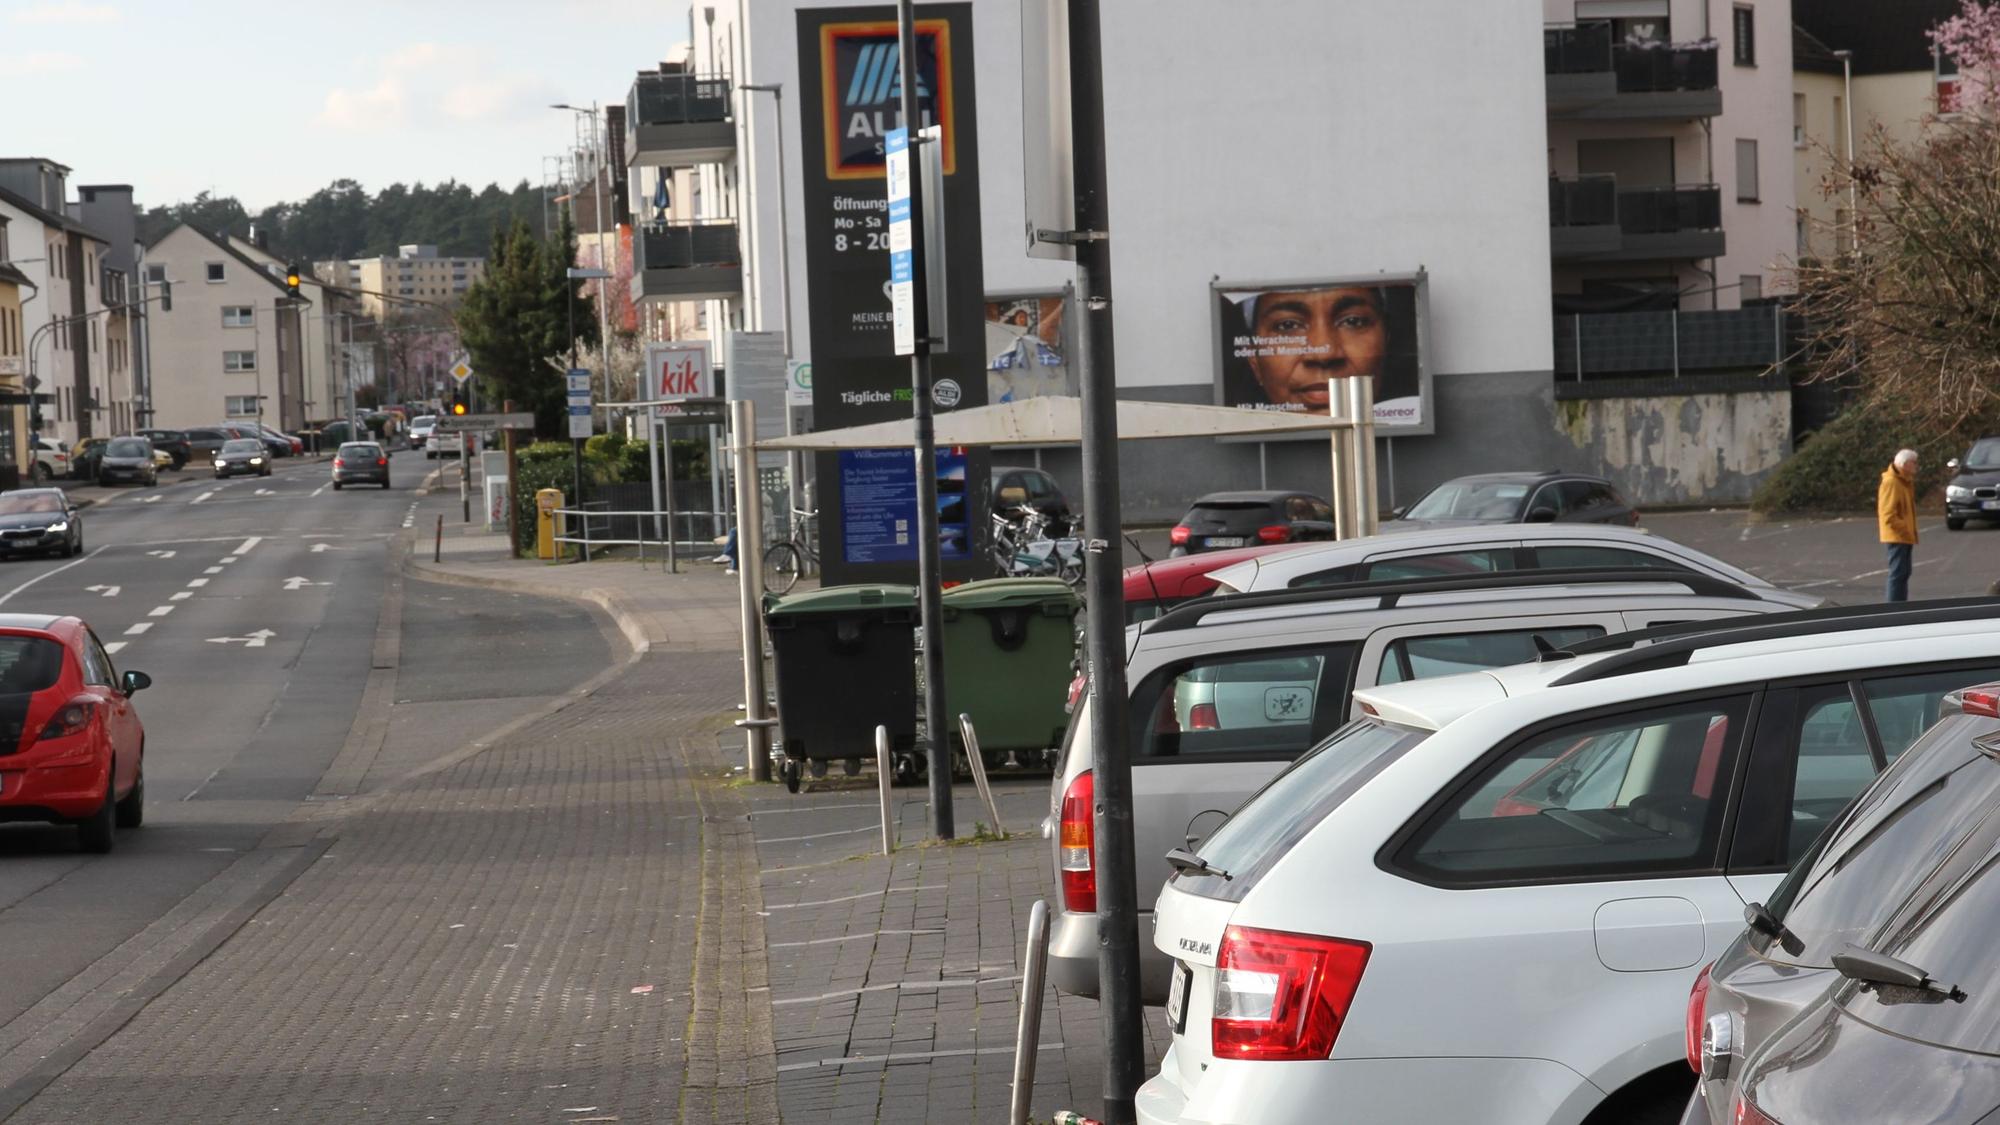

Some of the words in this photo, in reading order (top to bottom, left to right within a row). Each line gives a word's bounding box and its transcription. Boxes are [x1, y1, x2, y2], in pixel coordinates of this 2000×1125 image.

[834, 196, 889, 212] Öffnung
[834, 217, 854, 229] Mo
[866, 215, 882, 228] Sa
[835, 234, 848, 251] 8
[867, 232, 891, 250] 20
[852, 312, 885, 323] MEINE
[1234, 336, 1250, 346] Mit
[1252, 335, 1307, 347] Verachtung
[1234, 347, 1257, 358] oder
[1258, 346, 1275, 356] mit
[1277, 344, 1330, 356] Menschen?
[841, 390, 891, 406] Tägliche
